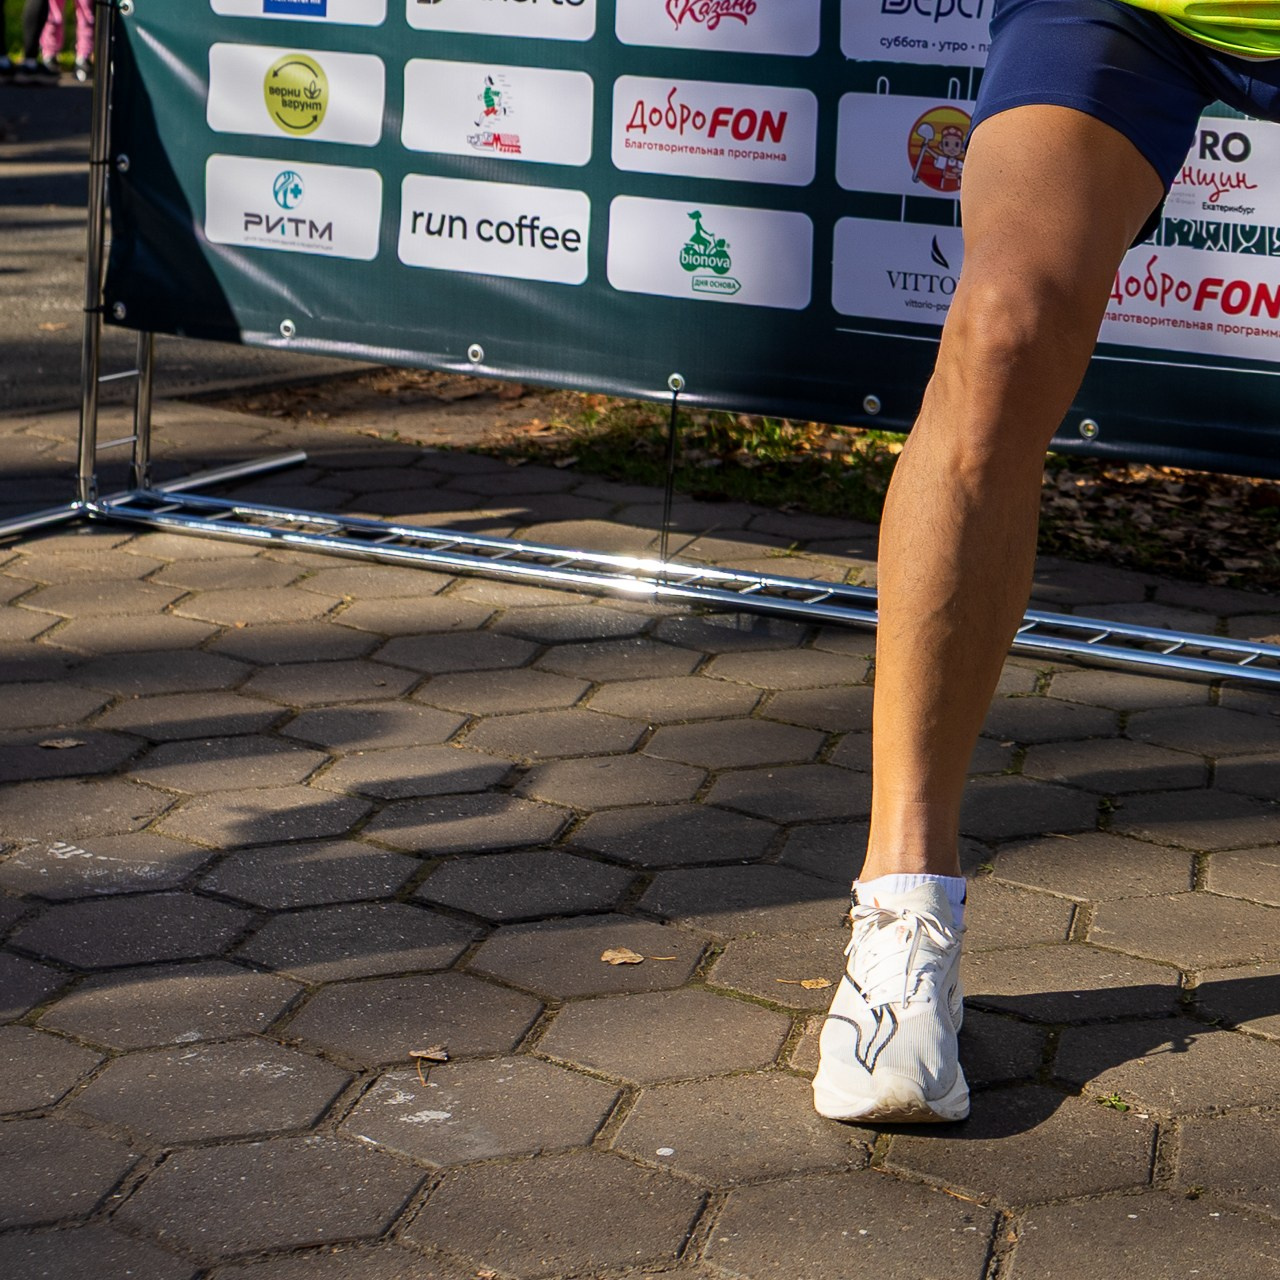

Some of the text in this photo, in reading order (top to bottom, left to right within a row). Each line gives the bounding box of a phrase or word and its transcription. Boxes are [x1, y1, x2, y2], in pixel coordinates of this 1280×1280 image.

[880, 36, 928, 49] суббота
[939, 40, 968, 53] утро
[268, 86, 300, 99] верни
[281, 97, 322, 112] вгрунт
[626, 86, 787, 143] ДоброFON
[625, 139, 787, 162] Благотворительная программа
[1192, 129, 1251, 163] RO
[244, 212, 333, 242] РИТМ
[411, 210, 581, 253] run coffee
[681, 250, 730, 268] bionova
[1104, 311, 1213, 332] лаготворительная
